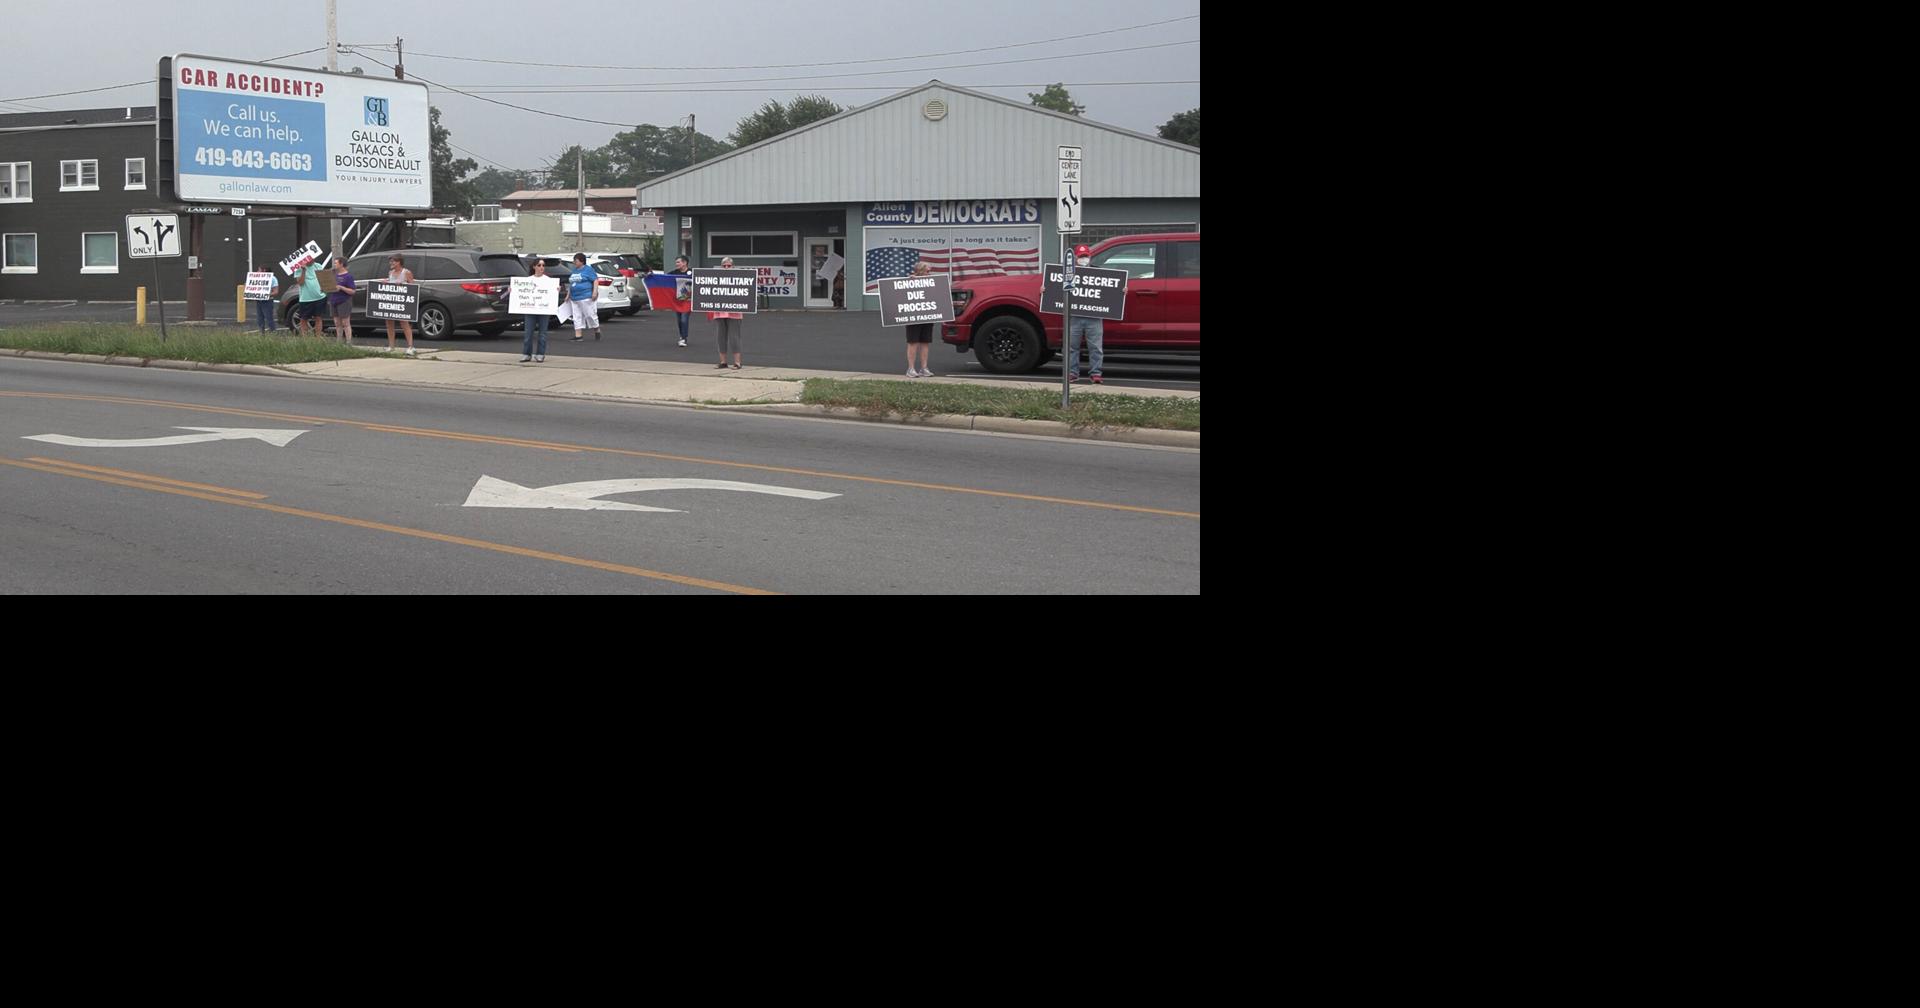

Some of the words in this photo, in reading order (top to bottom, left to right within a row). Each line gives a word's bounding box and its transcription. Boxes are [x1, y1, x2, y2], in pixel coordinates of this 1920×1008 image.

[181, 67, 218, 87] CAR
[226, 73, 324, 97] ACCIDENT?
[366, 97, 386, 112] GT
[228, 104, 256, 120] Call
[260, 111, 281, 123] us.
[203, 119, 230, 136] We
[234, 125, 261, 139] can
[266, 124, 304, 145] help.
[352, 130, 403, 145] GALLON,
[349, 143, 394, 157] TAKACS
[397, 146, 406, 158] &
[195, 147, 313, 172] 419-843-6663
[335, 155, 421, 170] BOISSONEAULT
[219, 181, 292, 194] gallonlaw.com
[872, 202, 906, 211] Allen
[914, 200, 1038, 223] DEMOCRATS
[866, 213, 912, 223] County
[965, 236, 983, 244] long
[282, 246, 309, 266] PEOPLE
[695, 277, 718, 285] USING
[719, 277, 754, 286] MILITARY
[893, 278, 935, 290] IGNORING
[1050, 272, 1080, 284] USG
[1082, 275, 1121, 288] SECRET
[378, 284, 408, 294] LABELING
[700, 287, 711, 295] ON
[712, 287, 749, 296] CIVILIANS
[1071, 287, 1101, 299] OLICE
[371, 293, 405, 302] MINORITIES
[907, 290, 925, 301] DUE
[378, 302, 406, 311] ENEMIES
[897, 301, 937, 313] PROCESS
[1079, 304, 1109, 312] FASCISM
[916, 313, 943, 321] FASCISM
